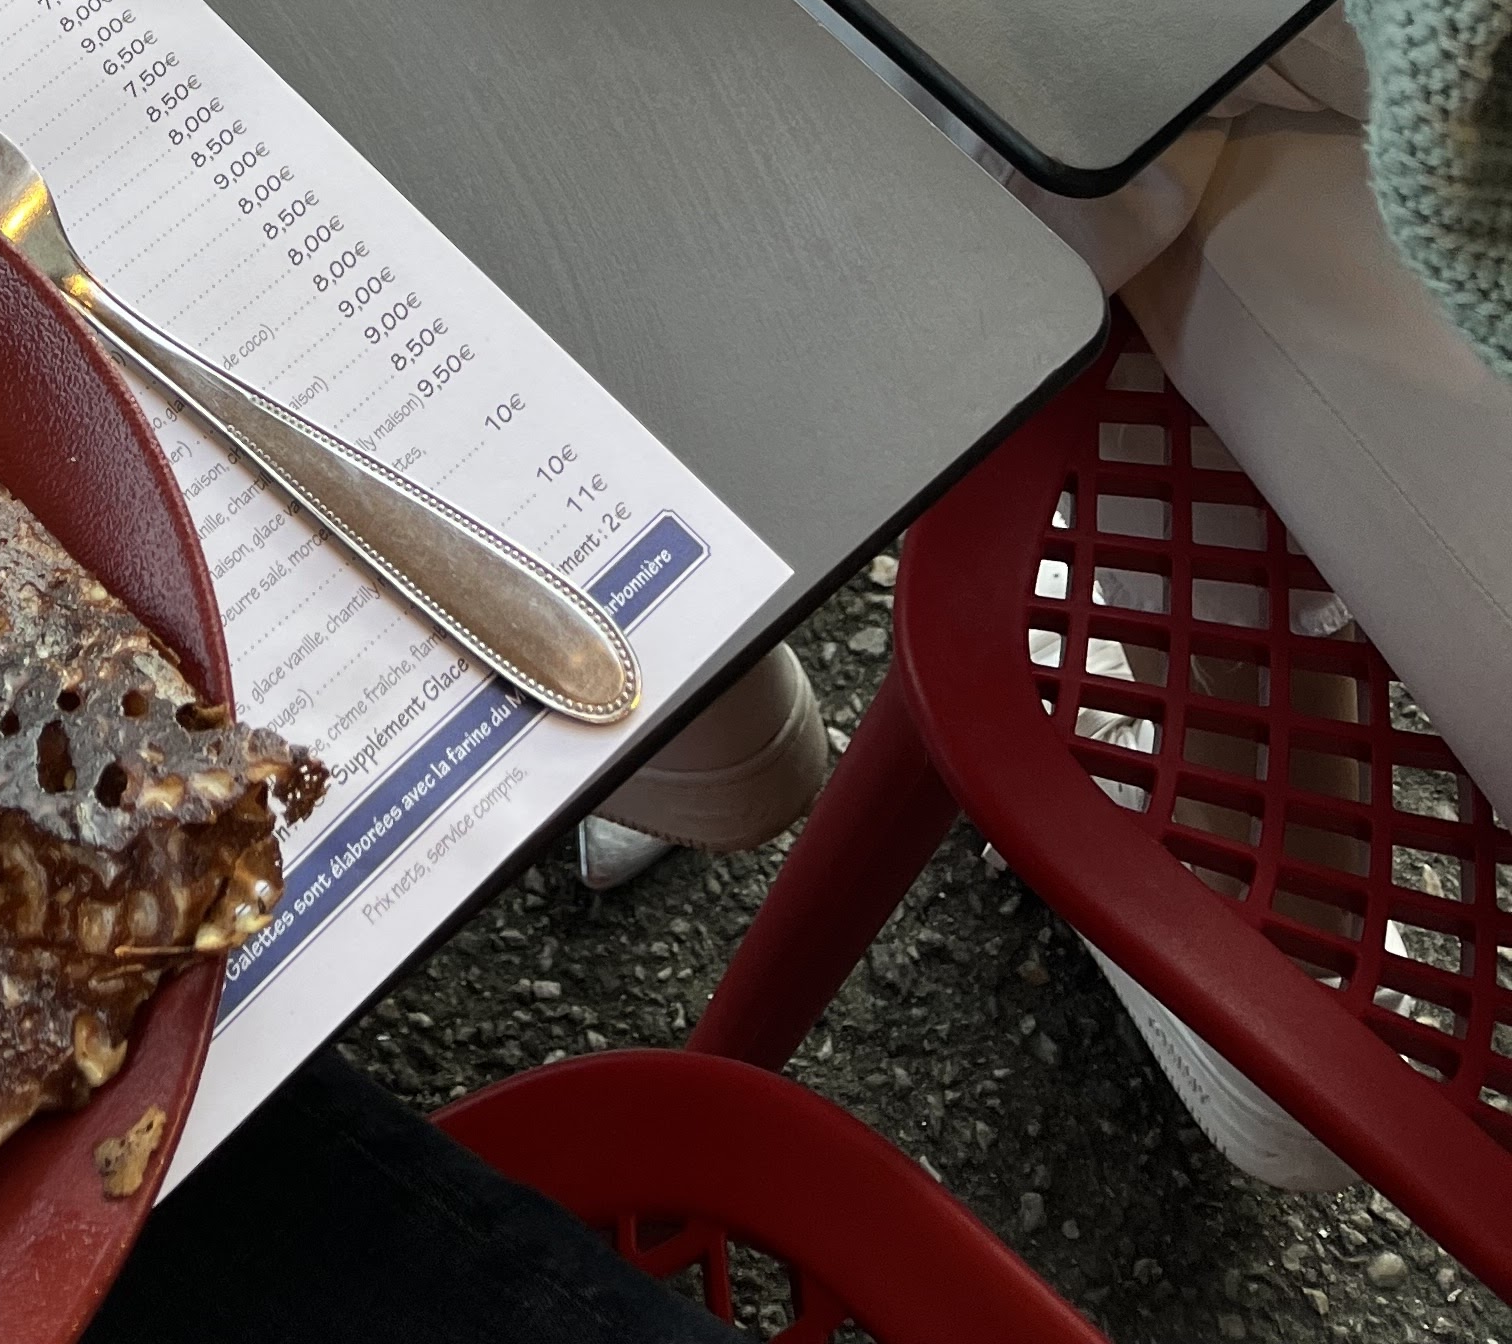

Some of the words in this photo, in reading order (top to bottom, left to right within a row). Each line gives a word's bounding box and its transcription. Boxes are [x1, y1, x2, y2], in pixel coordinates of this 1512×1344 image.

[81, 9, 136, 53] 9,00€
[103, 30, 158, 75] 6,50€
[123, 52, 180, 98] 7,50€
[146, 75, 202, 122] 8,50€
[169, 97, 224, 145] 8,00€
[191, 119, 247, 167] 8,50€
[214, 142, 270, 189] 9,00€
[238, 165, 295, 214] 8,00€
[263, 190, 319, 240] 8,50€
[288, 215, 344, 266] 8,00€
[313, 240, 370, 292] 8,00€
[338, 266, 396, 318] 9,00€
[238, 323, 276, 359] coco)
[364, 292, 422, 344] 9,00€
[391, 318, 449, 371] 8,50€
[417, 344, 476, 397] 9,50€
[484, 392, 526, 432] 10€
[536, 443, 578, 483] 10€
[566, 473, 608, 513] 11€
[602, 501, 632, 533] 2€
[251, 514, 286, 551] glace
[259, 560, 292, 593] salé,
[251, 666, 286, 705] glace
[285, 629, 329, 671] vanille,
[326, 581, 382, 633] chantilly
[328, 703, 369, 743] crème
[330, 696, 426, 786] Supplément
[422, 656, 470, 701] Glace
[225, 911, 295, 982] Galettes
[294, 873, 333, 915] sont
[330, 806, 403, 880] élaborées
[401, 776, 436, 811] avec
[435, 757, 452, 780] la
[444, 721, 492, 765] farine
[490, 702, 512, 728] du
[362, 892, 393, 926] Prix
[391, 861, 433, 898] nets,
[427, 813, 475, 864] service
